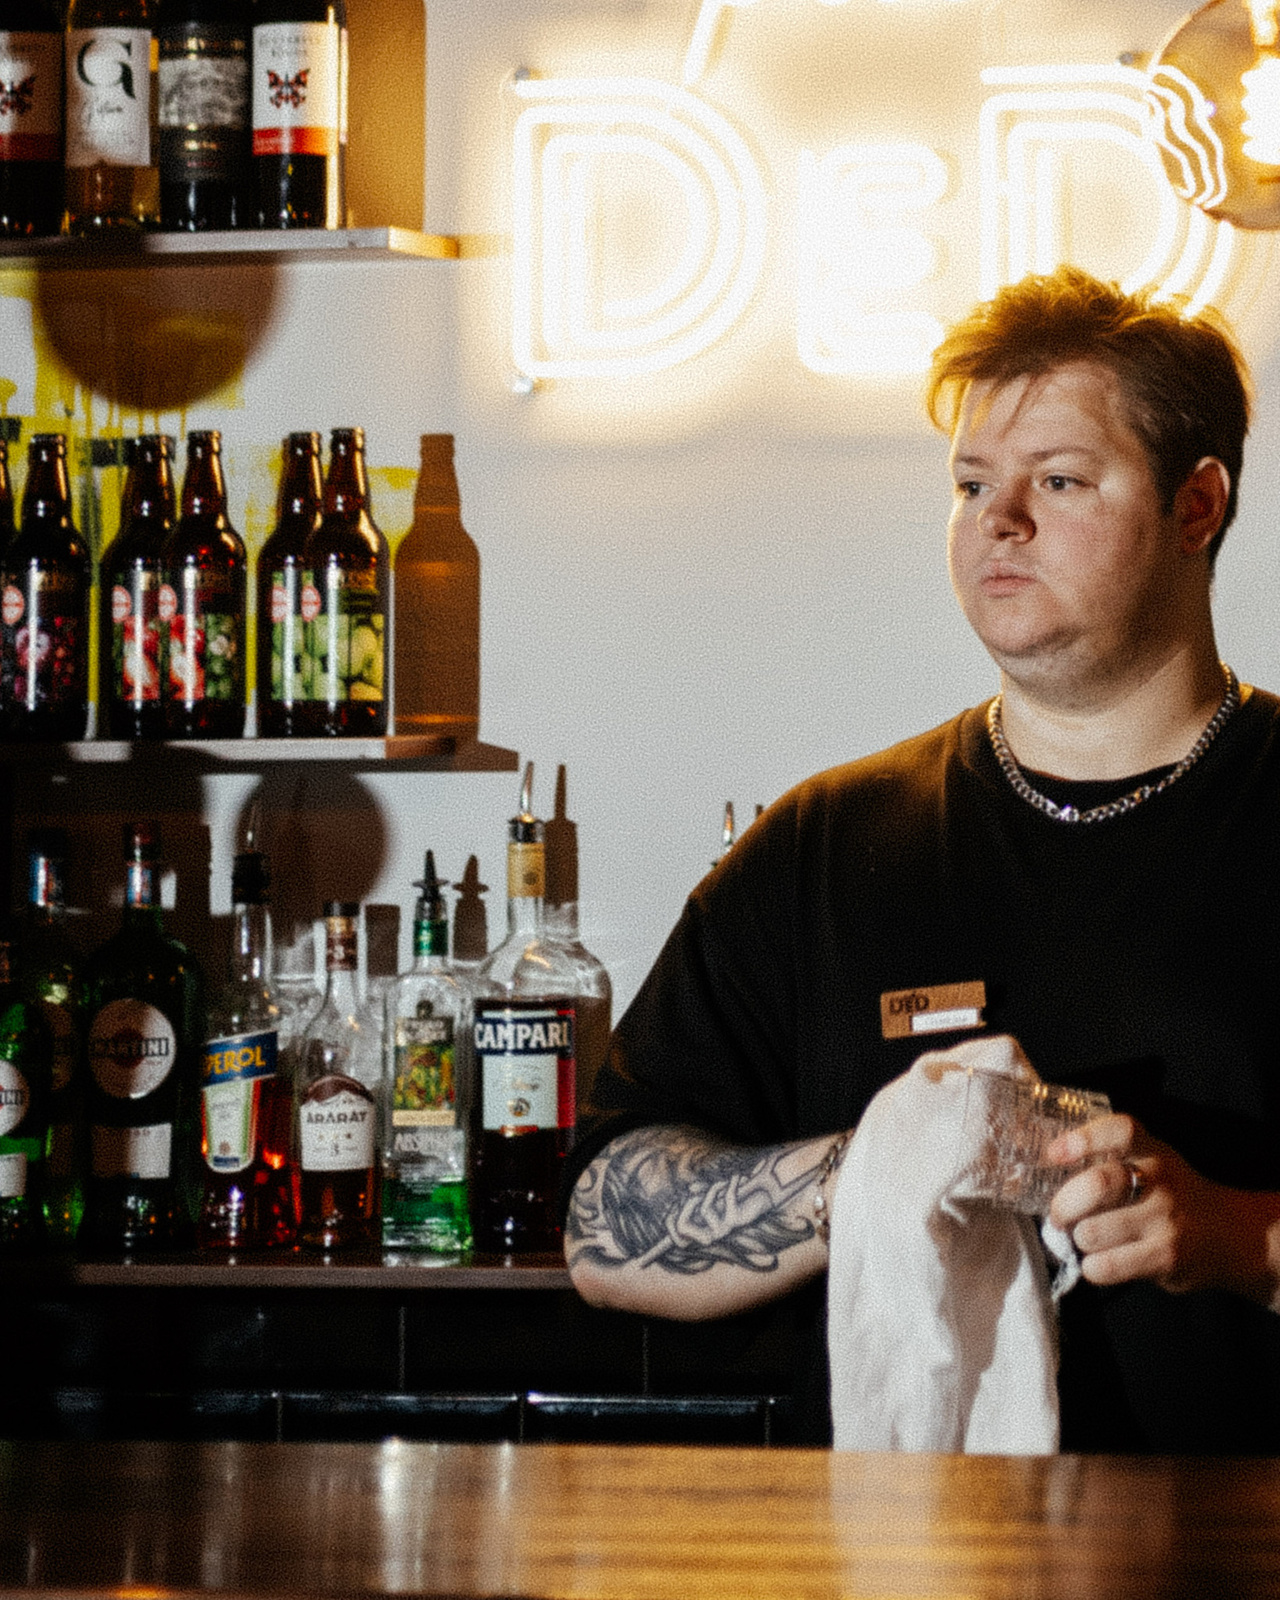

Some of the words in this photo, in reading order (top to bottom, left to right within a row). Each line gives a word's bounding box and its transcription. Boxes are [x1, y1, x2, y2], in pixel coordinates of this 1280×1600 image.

[474, 1020, 569, 1051] CAMPARI
[205, 1045, 267, 1077] PEROL
[306, 1110, 368, 1125] ARARAT
